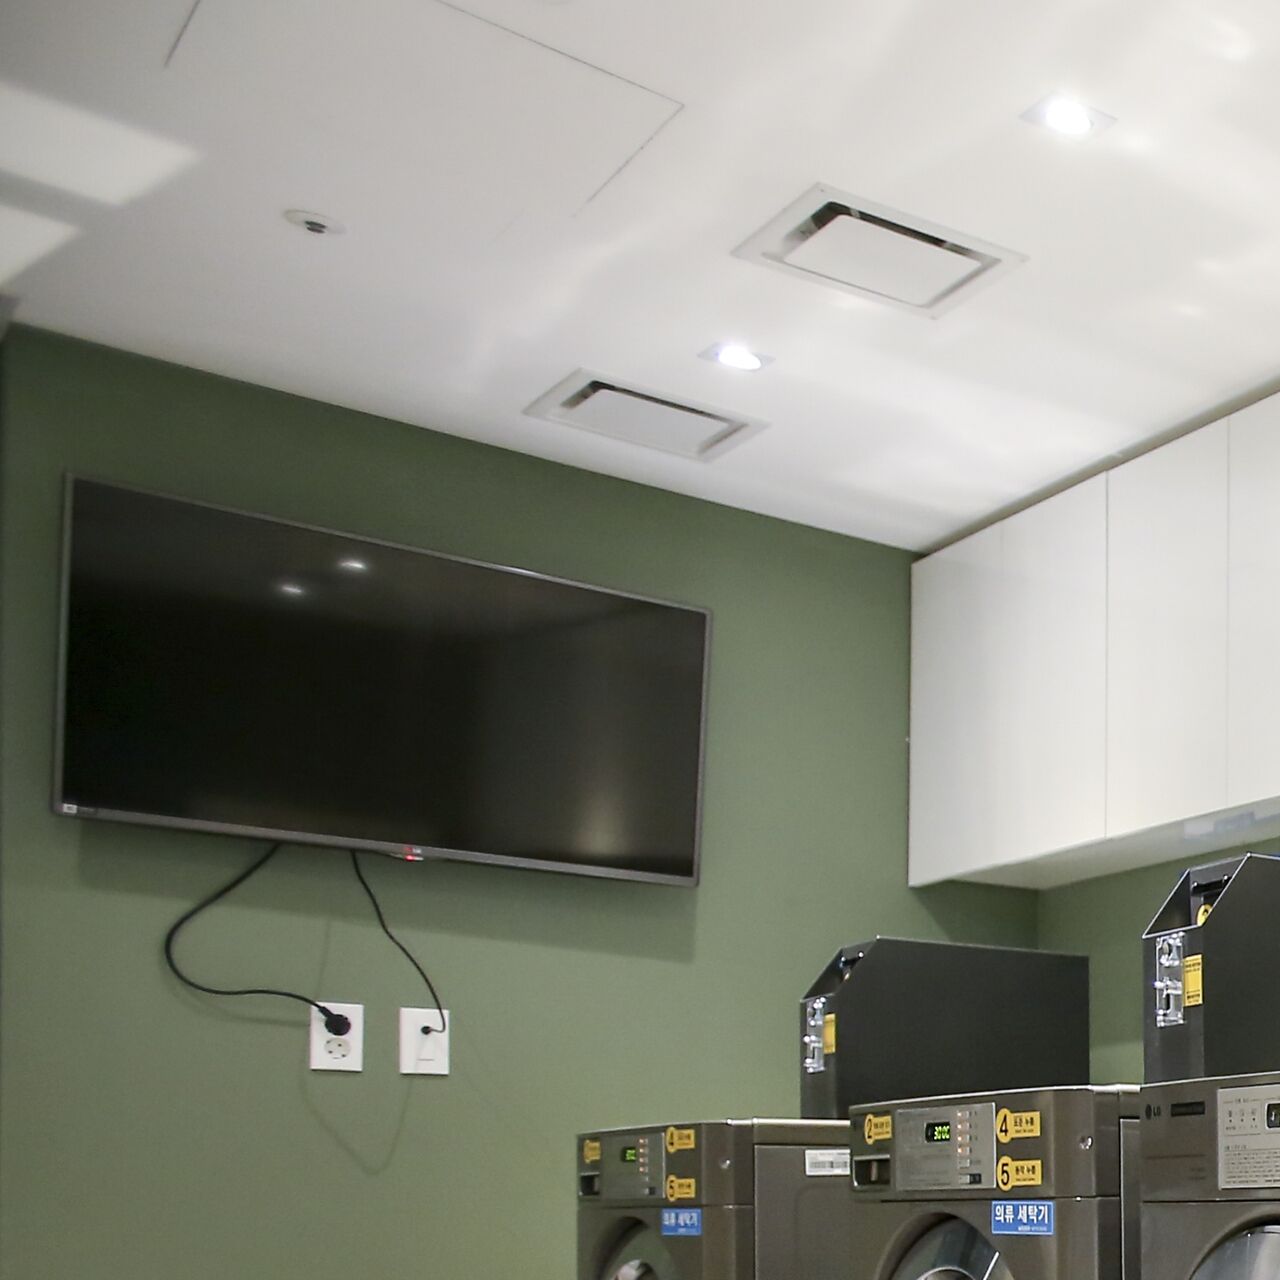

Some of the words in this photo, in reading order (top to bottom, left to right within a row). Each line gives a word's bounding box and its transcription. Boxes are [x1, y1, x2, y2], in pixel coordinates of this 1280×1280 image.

[867, 1119, 872, 1139] 2
[1000, 1114, 1008, 1136] 4
[1001, 1163, 1009, 1186] 5
[995, 1204, 1014, 1223] 의류
[1017, 1204, 1048, 1224] 세탁기
